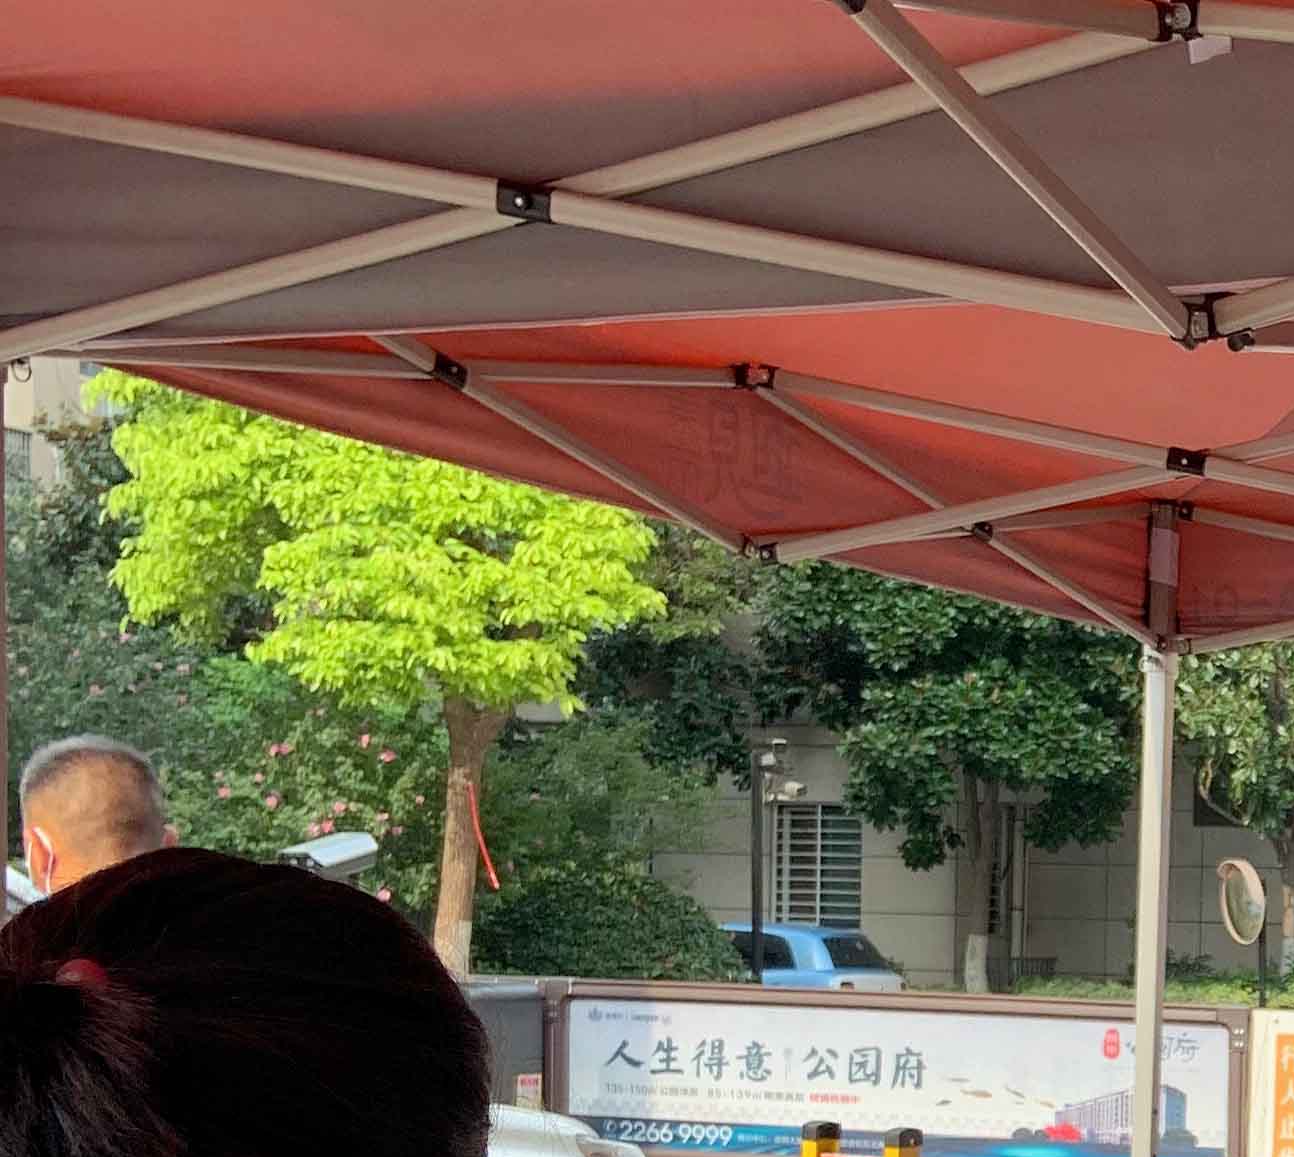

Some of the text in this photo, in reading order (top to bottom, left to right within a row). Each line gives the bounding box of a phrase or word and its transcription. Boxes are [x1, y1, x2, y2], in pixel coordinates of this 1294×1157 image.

[603, 1036, 927, 1090] 人生得意 公园府
[619, 1120, 673, 1144] 2266
[677, 1126, 733, 1148] 9999
